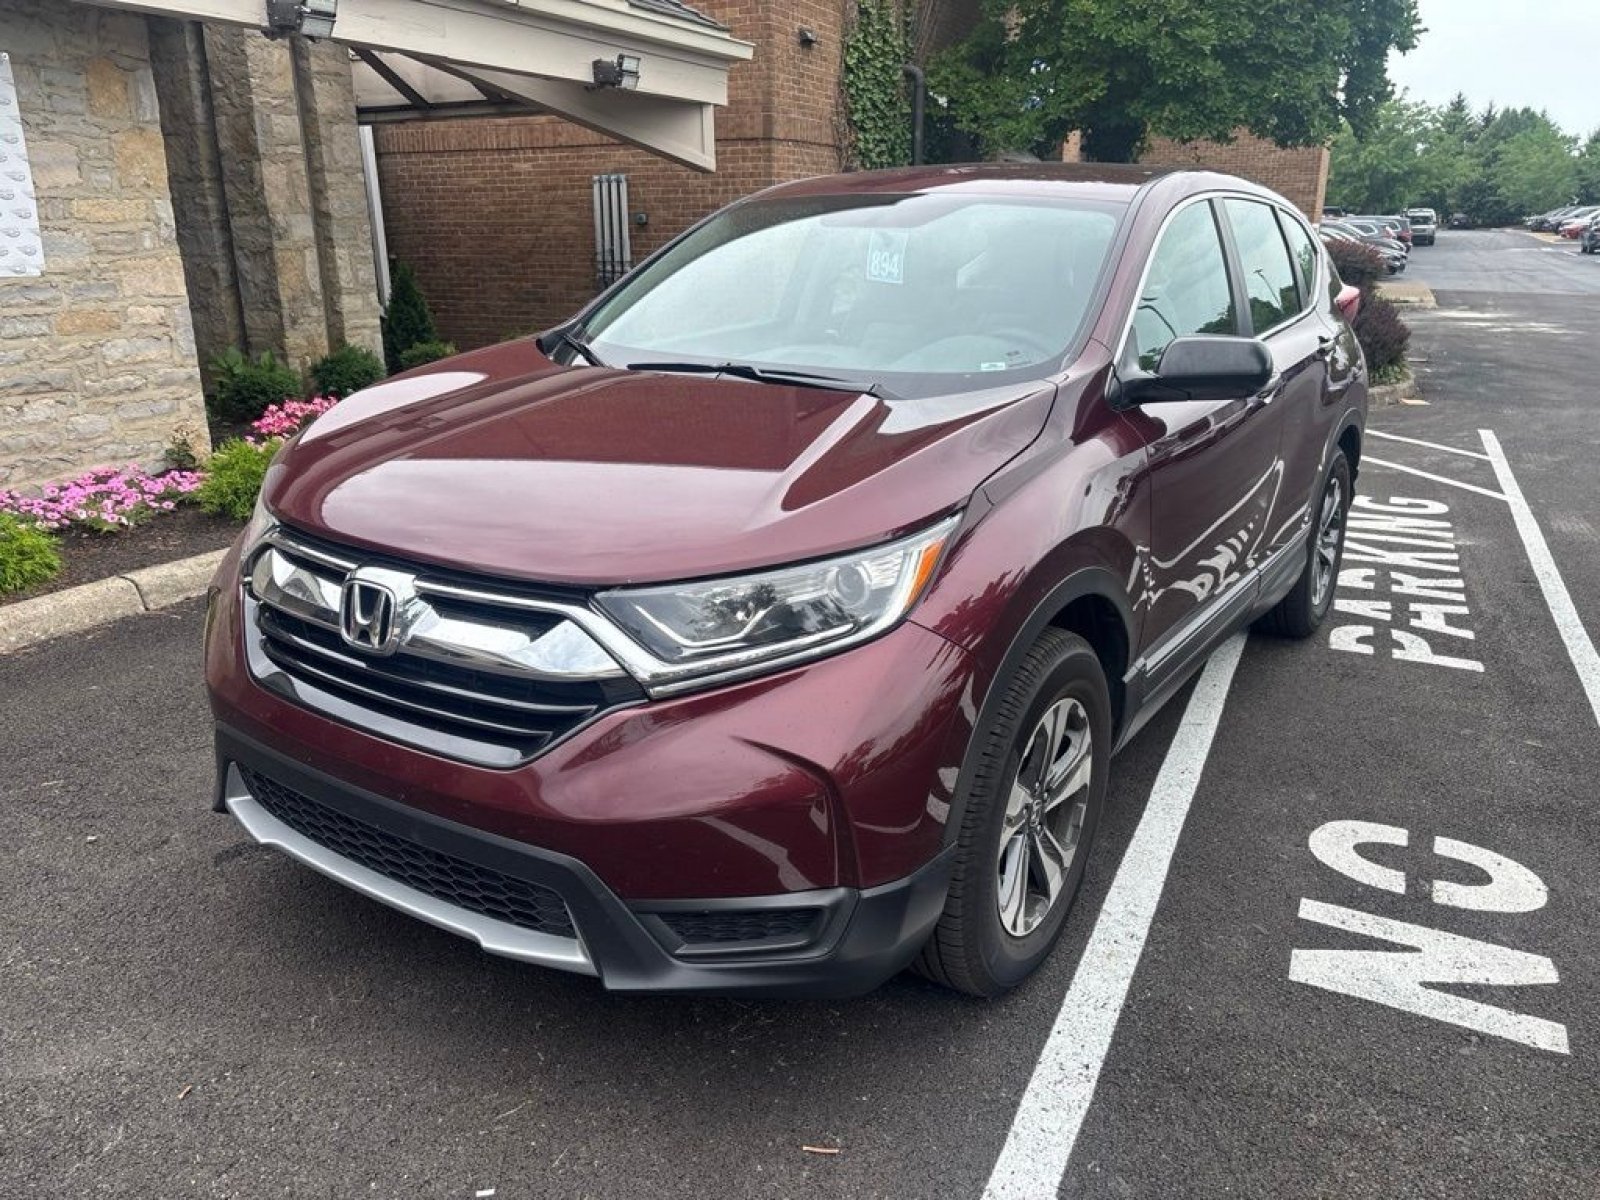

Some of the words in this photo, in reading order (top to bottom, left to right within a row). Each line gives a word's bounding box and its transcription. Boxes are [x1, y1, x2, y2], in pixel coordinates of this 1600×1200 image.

[871, 250, 900, 277] 894
[1329, 494, 1486, 672] PARKING
[1288, 819, 1570, 1054] NO
